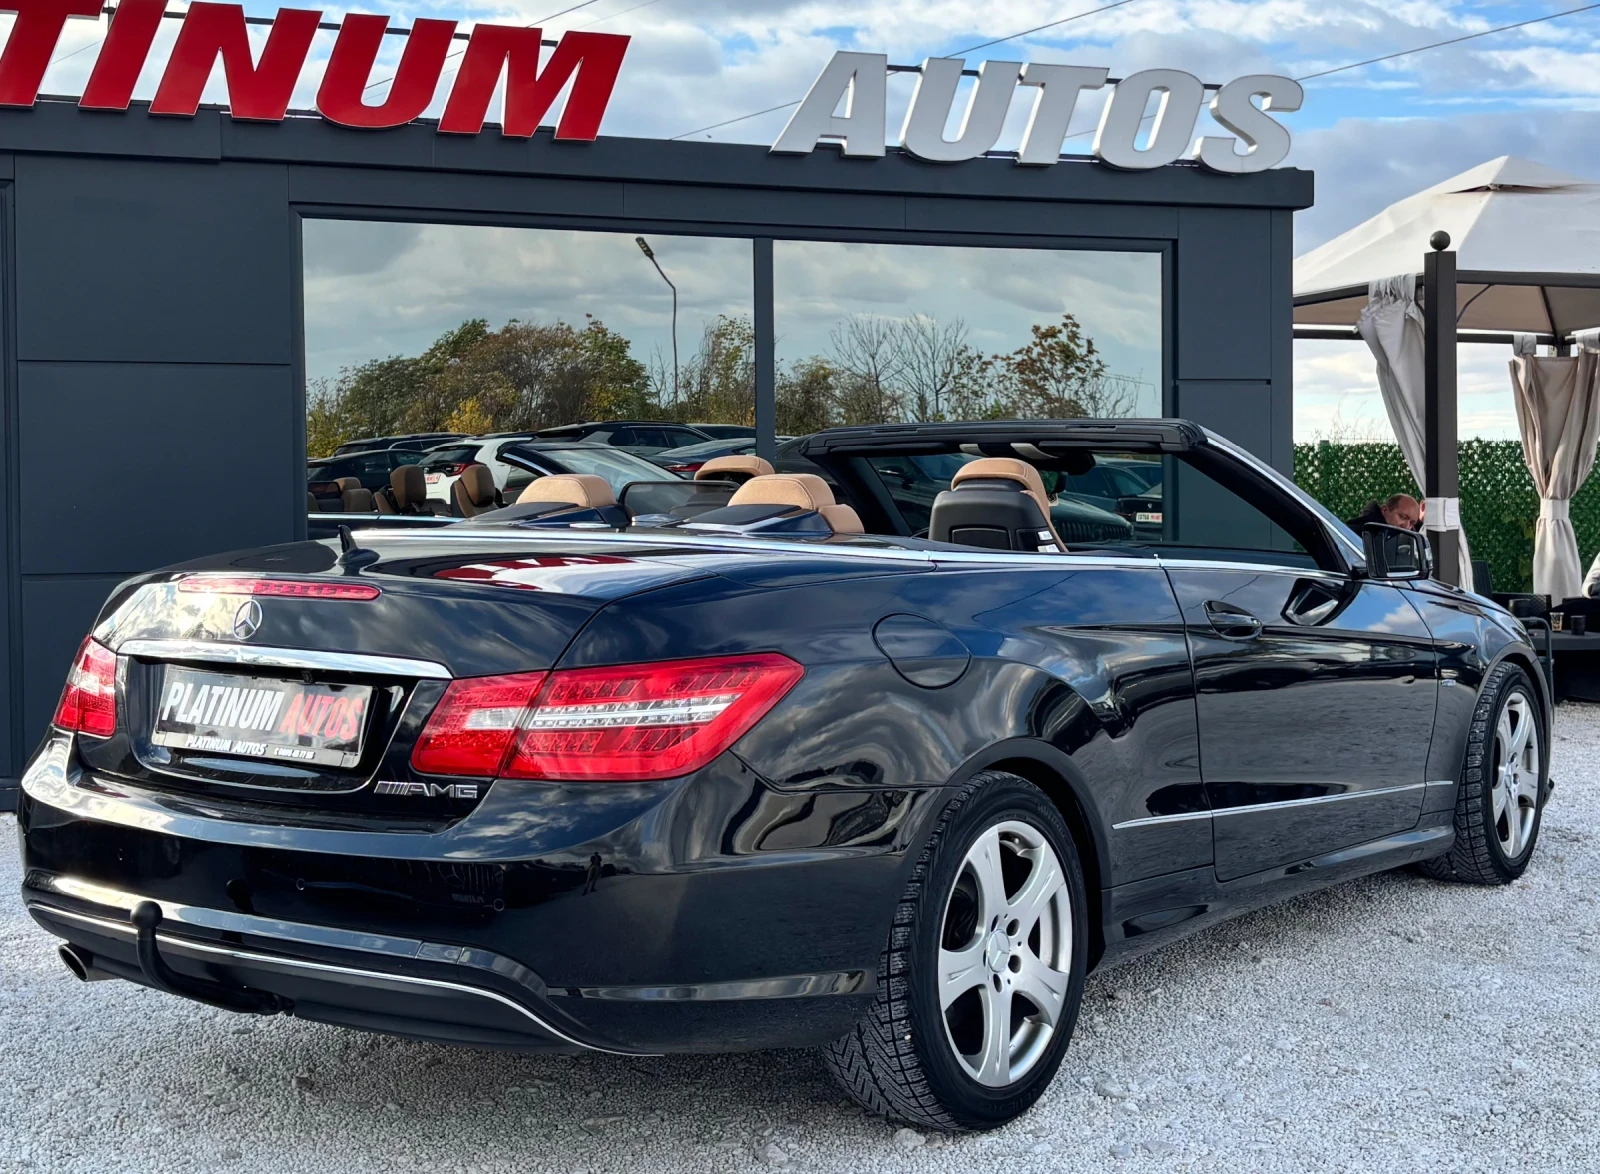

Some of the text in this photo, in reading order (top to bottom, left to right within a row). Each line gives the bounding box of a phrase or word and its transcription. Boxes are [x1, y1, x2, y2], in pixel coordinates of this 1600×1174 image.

[769, 51, 1304, 173] AUTOS
[162, 682, 363, 740] PLATINUM AUTOS
[185, 735, 232, 752] PLATINUM
[231, 741, 268, 755] AUTOS
[403, 782, 477, 798] AMG
